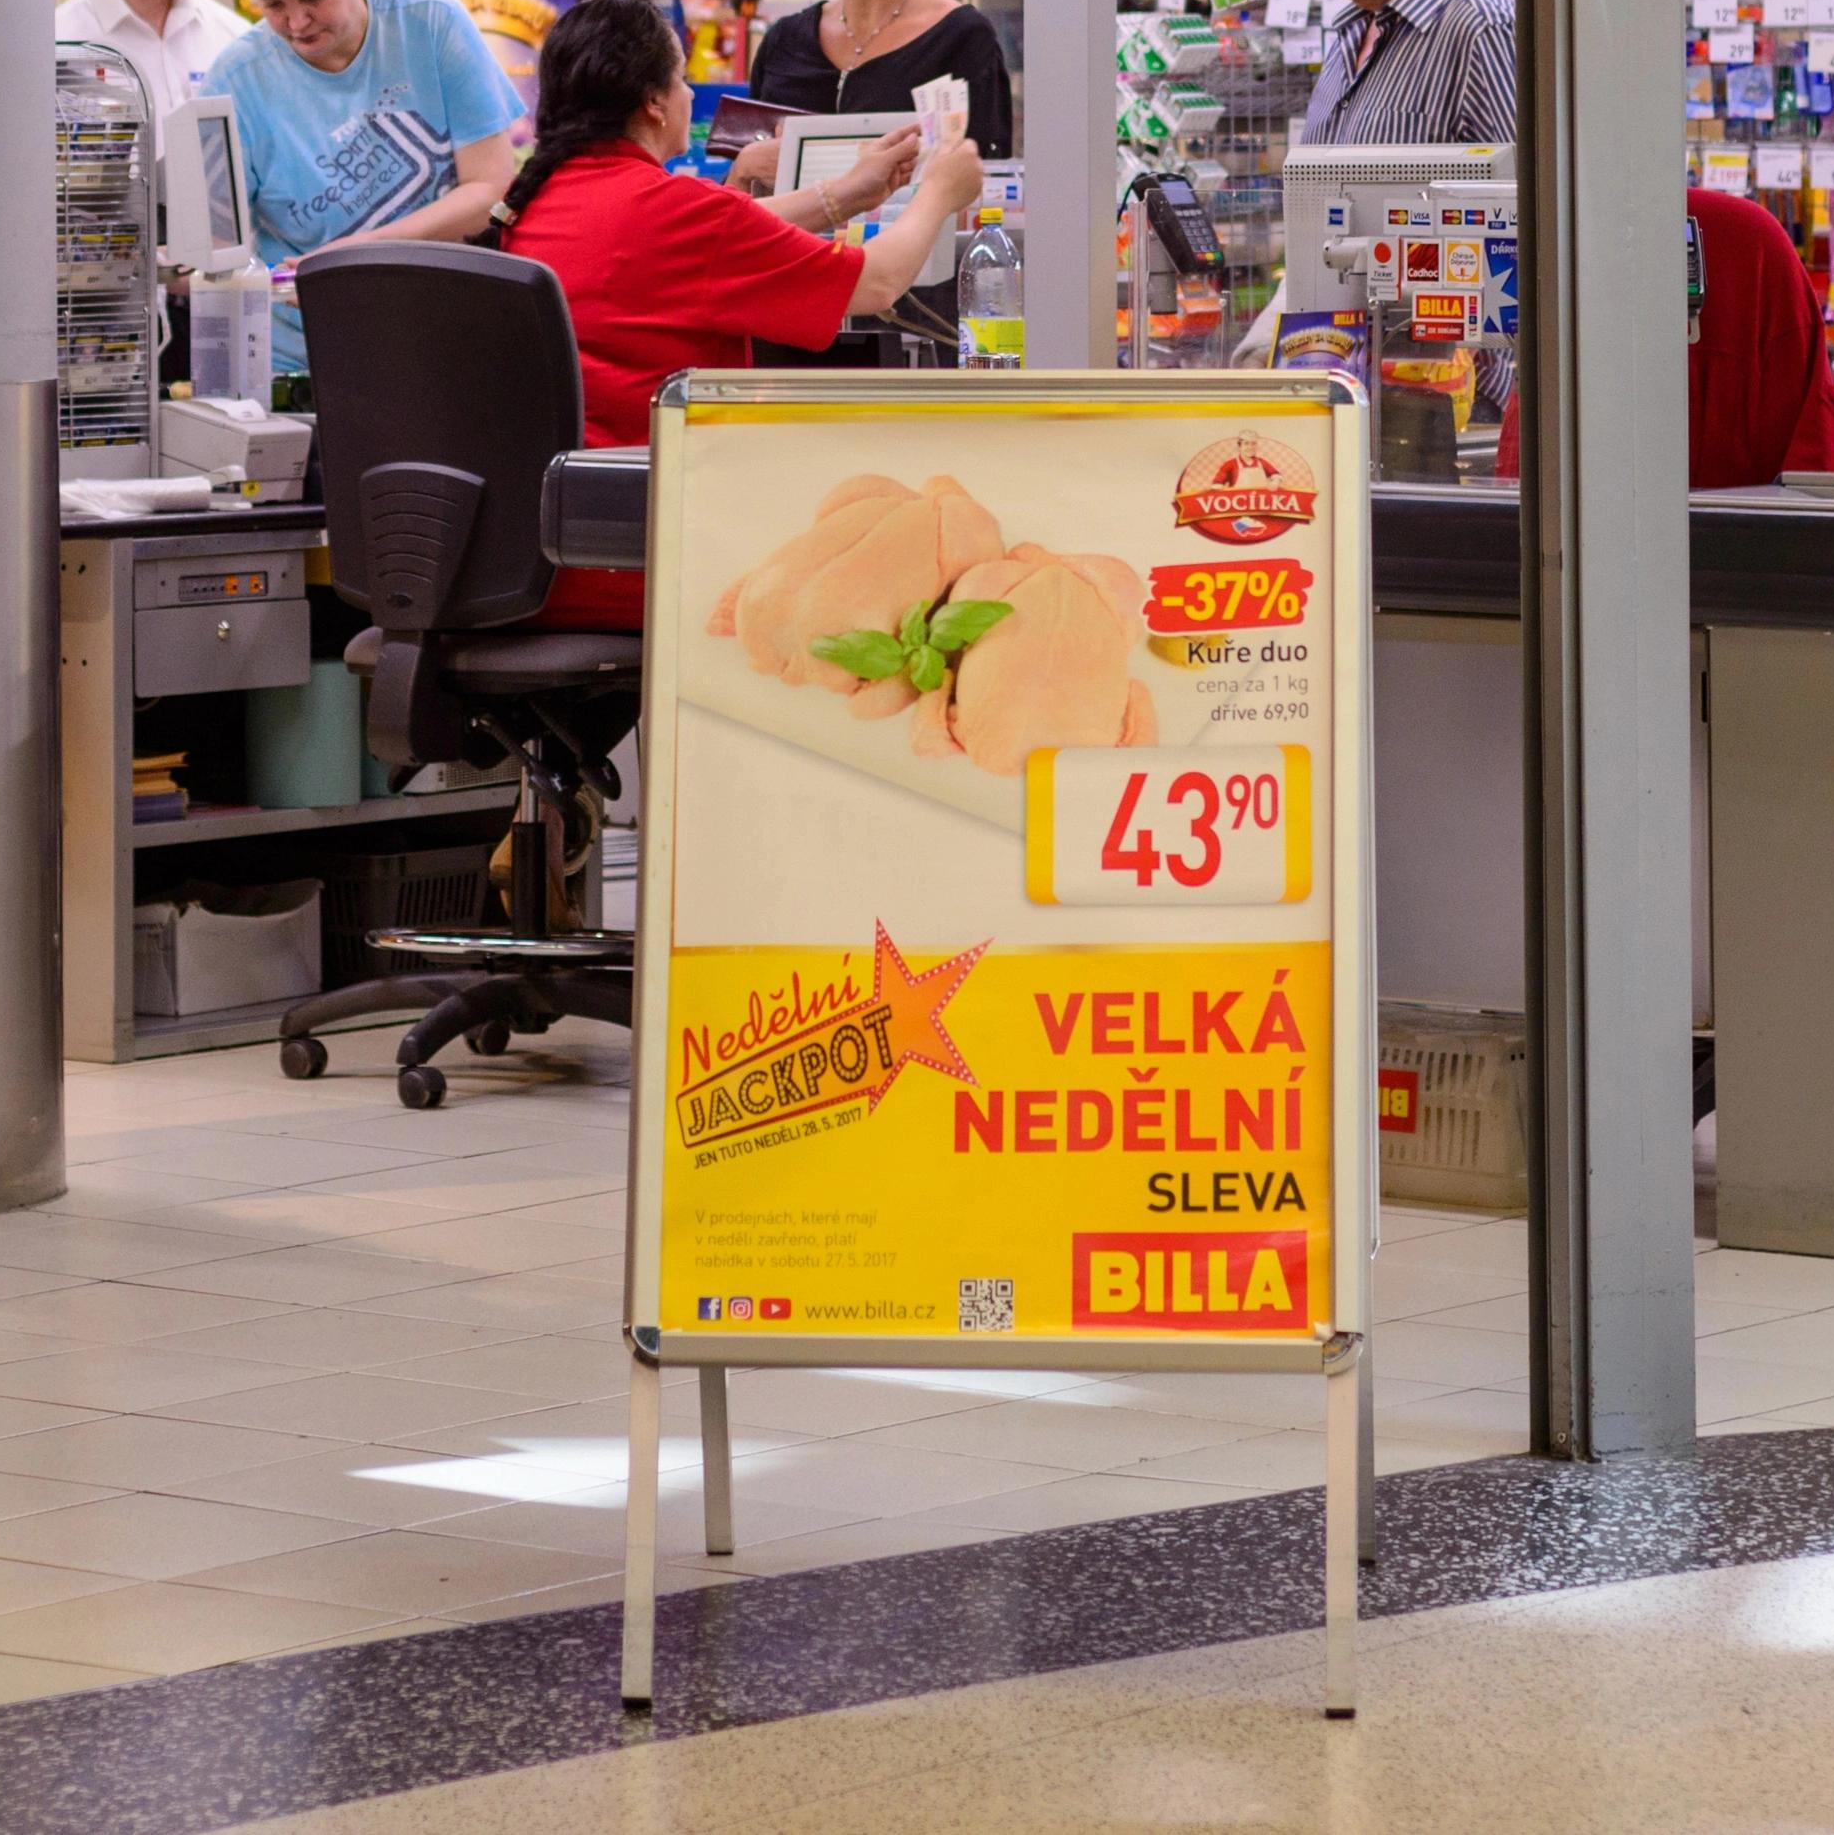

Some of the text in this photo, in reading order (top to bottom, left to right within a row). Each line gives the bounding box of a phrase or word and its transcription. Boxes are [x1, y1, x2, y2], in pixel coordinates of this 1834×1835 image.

[1408, 267, 1439, 279] Cadhoc
[1418, 299, 1463, 316] BILLA
[1196, 490, 1302, 514] VOCÍLKA
[1161, 569, 1300, 623] -37%
[1188, 639, 1308, 664] Kuře duo
[1196, 674, 1309, 695] cena za 1 kg
[1210, 702, 1309, 723] dříve 69,90
[681, 952, 861, 1086] Nedělní
[1035, 968, 1306, 1056] VELKÁ
[687, 1005, 895, 1138] JACKPOT
[954, 1066, 1303, 1154] NEDĚLNÍ
[693, 1107, 862, 1170] JEN TUTO NEDĚLI 28. 5. 2017
[1148, 1170, 1308, 1214] SLEVA
[695, 1208, 879, 1229] V prodejnách, které mají
[695, 1230, 858, 1248] v neděli zavřeno, platí
[694, 1252, 754, 1269] nabídka
[757, 1256, 766, 1268] v
[769, 1253, 821, 1269] sobotu
[866, 1252, 897, 1268] 2017
[1089, 1249, 1294, 1313] BILLA
[805, 1300, 937, 1322] www.billa.cz
